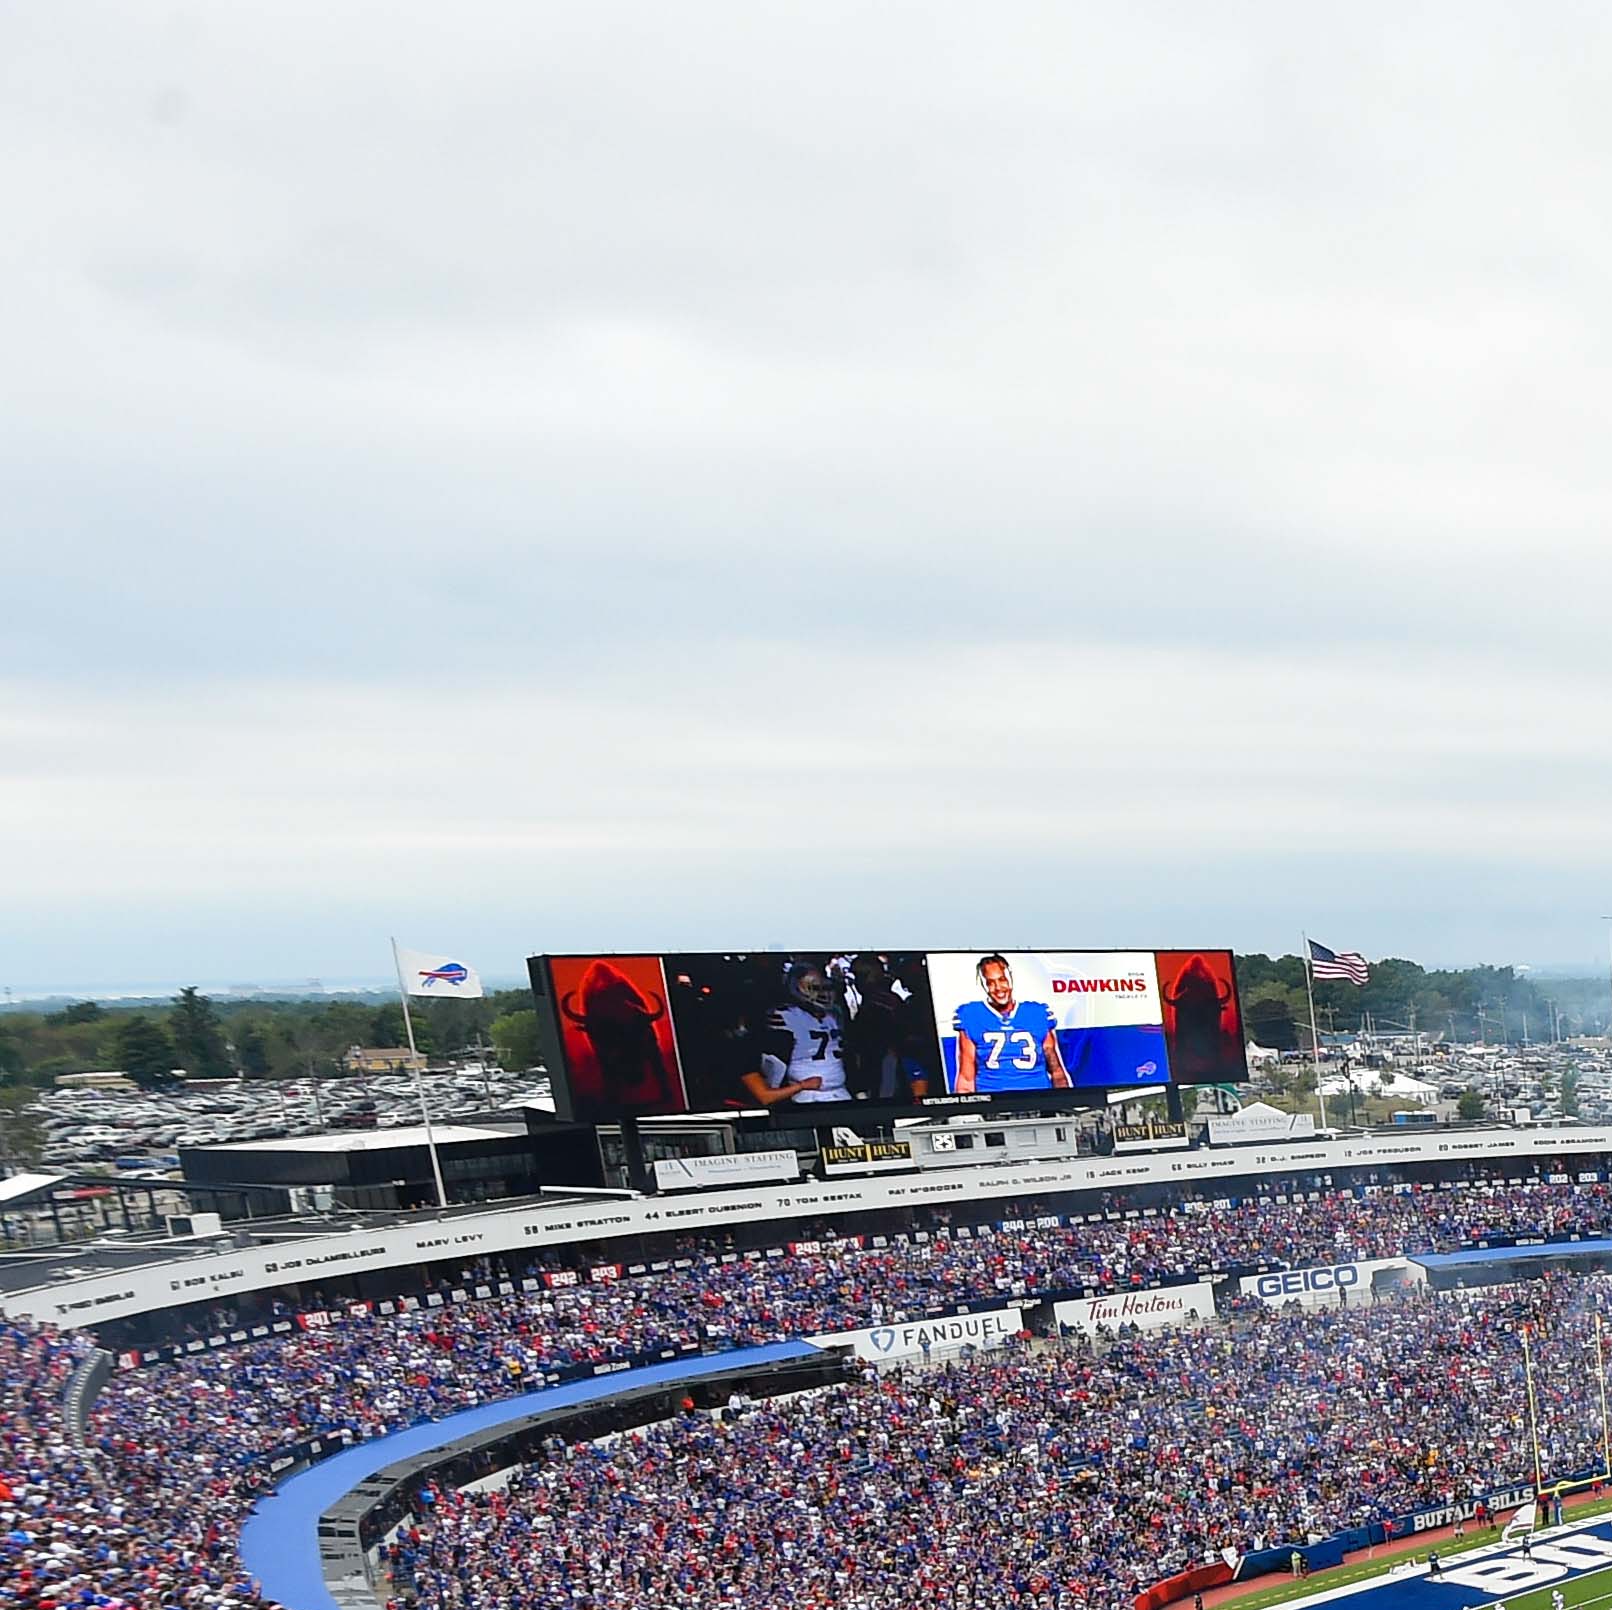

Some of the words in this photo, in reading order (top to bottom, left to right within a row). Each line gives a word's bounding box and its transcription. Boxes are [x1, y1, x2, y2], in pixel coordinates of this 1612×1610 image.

[1052, 979, 1147, 993] DAWKINS
[983, 1032, 1037, 1070] 73
[1117, 1125, 1148, 1136] HUNT
[1154, 1123, 1184, 1134] HUNT
[828, 1146, 865, 1159] HUNT
[873, 1143, 907, 1155] HUNT
[694, 1157, 739, 1167] IMAGINE
[745, 1152, 794, 1164] STAFFING
[795, 1195, 820, 1205] TOM
[887, 1187, 907, 1197] PAT
[645, 1210, 661, 1220] 44
[523, 1225, 540, 1236] 58
[544, 1222, 573, 1233] MIKE
[576, 1215, 632, 1229] STRATTON
[416, 1237, 450, 1249] MARV
[454, 1232, 485, 1244] LEVY
[550, 1271, 579, 1287] 242
[1257, 1265, 1359, 1298] GEICO
[1086, 1298, 1119, 1321] Tim
[1121, 1295, 1183, 1317] Hortons
[902, 1316, 1009, 1347] FANDUEL
[1488, 1487, 1536, 1512] BILLS
